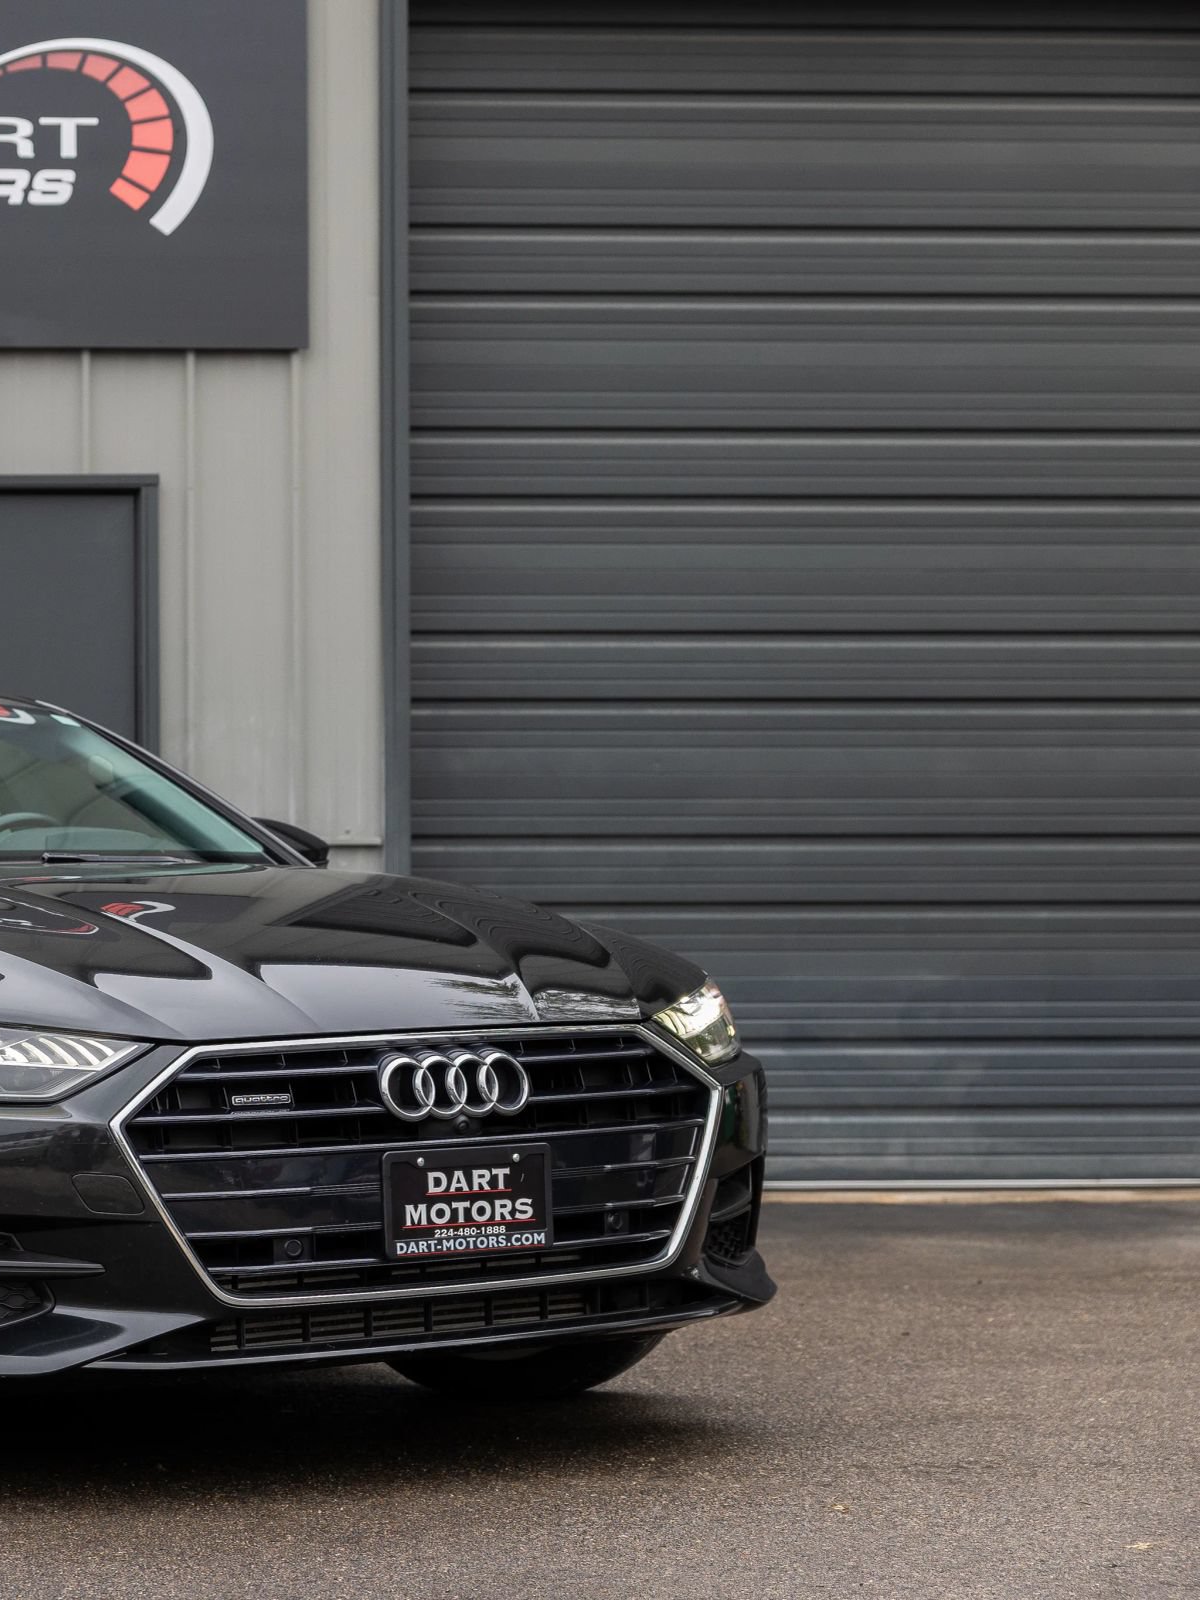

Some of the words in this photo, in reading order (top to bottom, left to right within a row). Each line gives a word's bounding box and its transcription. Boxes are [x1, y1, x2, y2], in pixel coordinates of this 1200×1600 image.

[234, 1094, 289, 1104] quattro
[427, 1167, 511, 1193] DART
[404, 1198, 534, 1227] MOTORS
[396, 1232, 546, 1255] DART-MOTORS.COM
[434, 1226, 506, 1238] 224-480-1888
